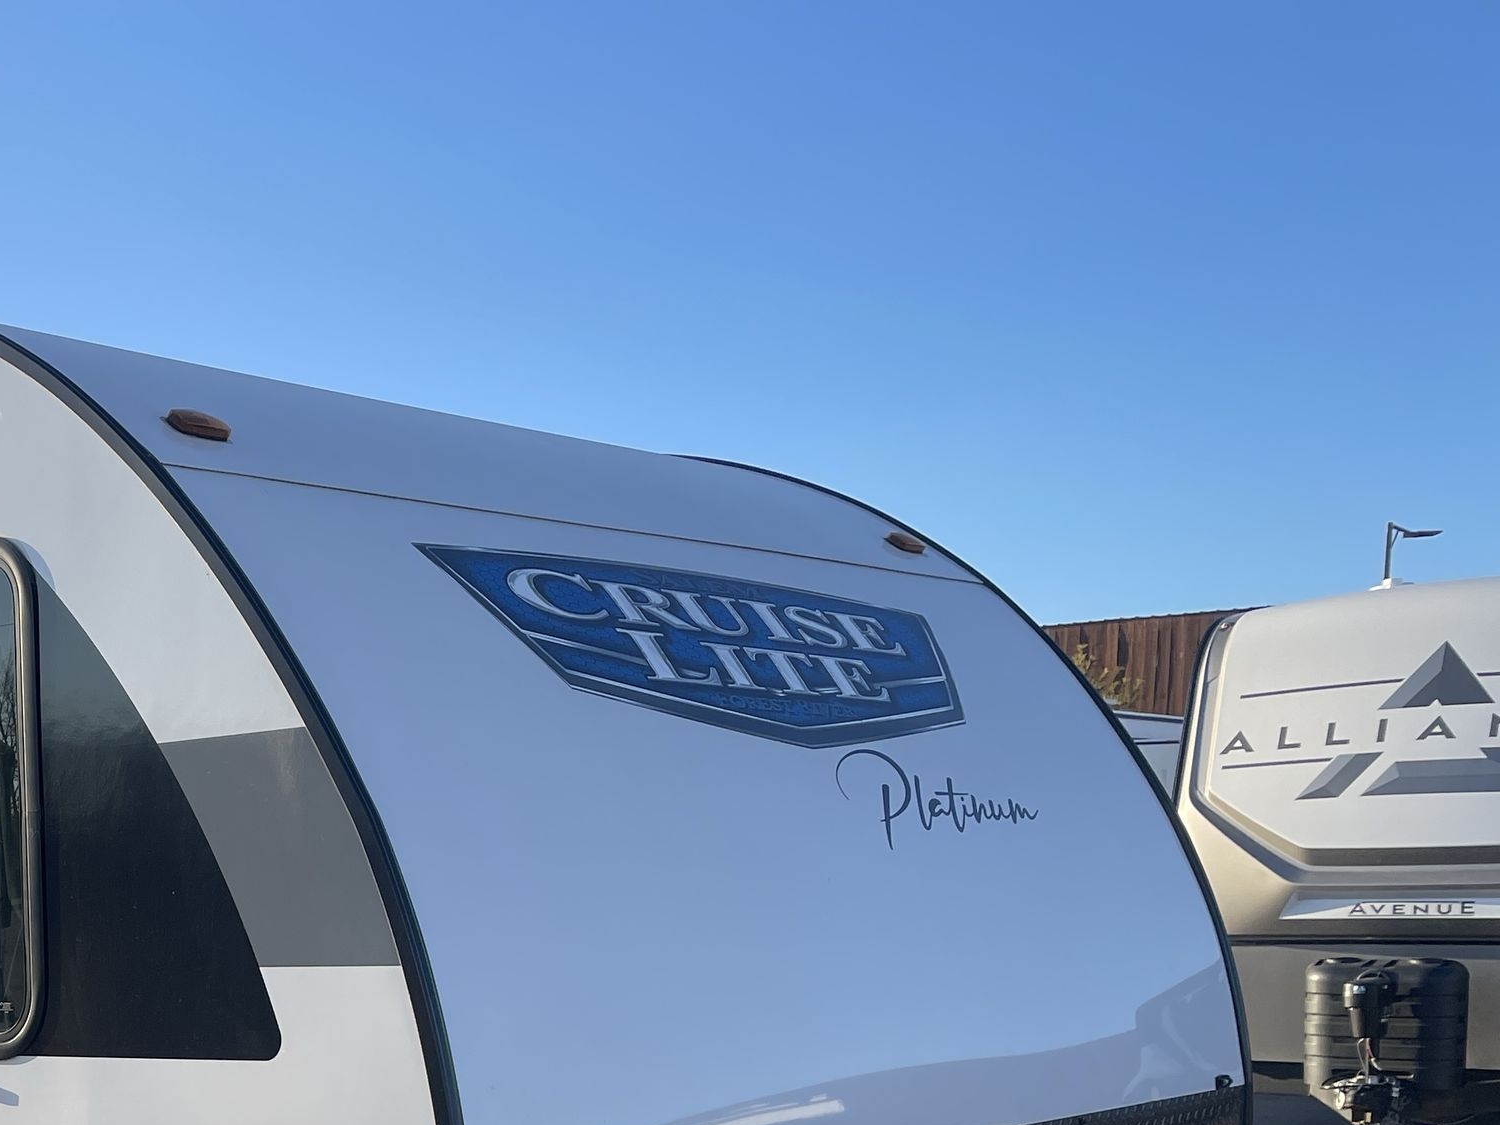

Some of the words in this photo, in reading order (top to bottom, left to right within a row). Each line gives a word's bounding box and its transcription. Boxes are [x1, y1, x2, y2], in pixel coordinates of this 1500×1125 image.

[506, 567, 905, 655] CRUISE
[615, 627, 891, 701] LITE
[835, 748, 1039, 850] Platinum
[1349, 901, 1476, 915] AVENUE
